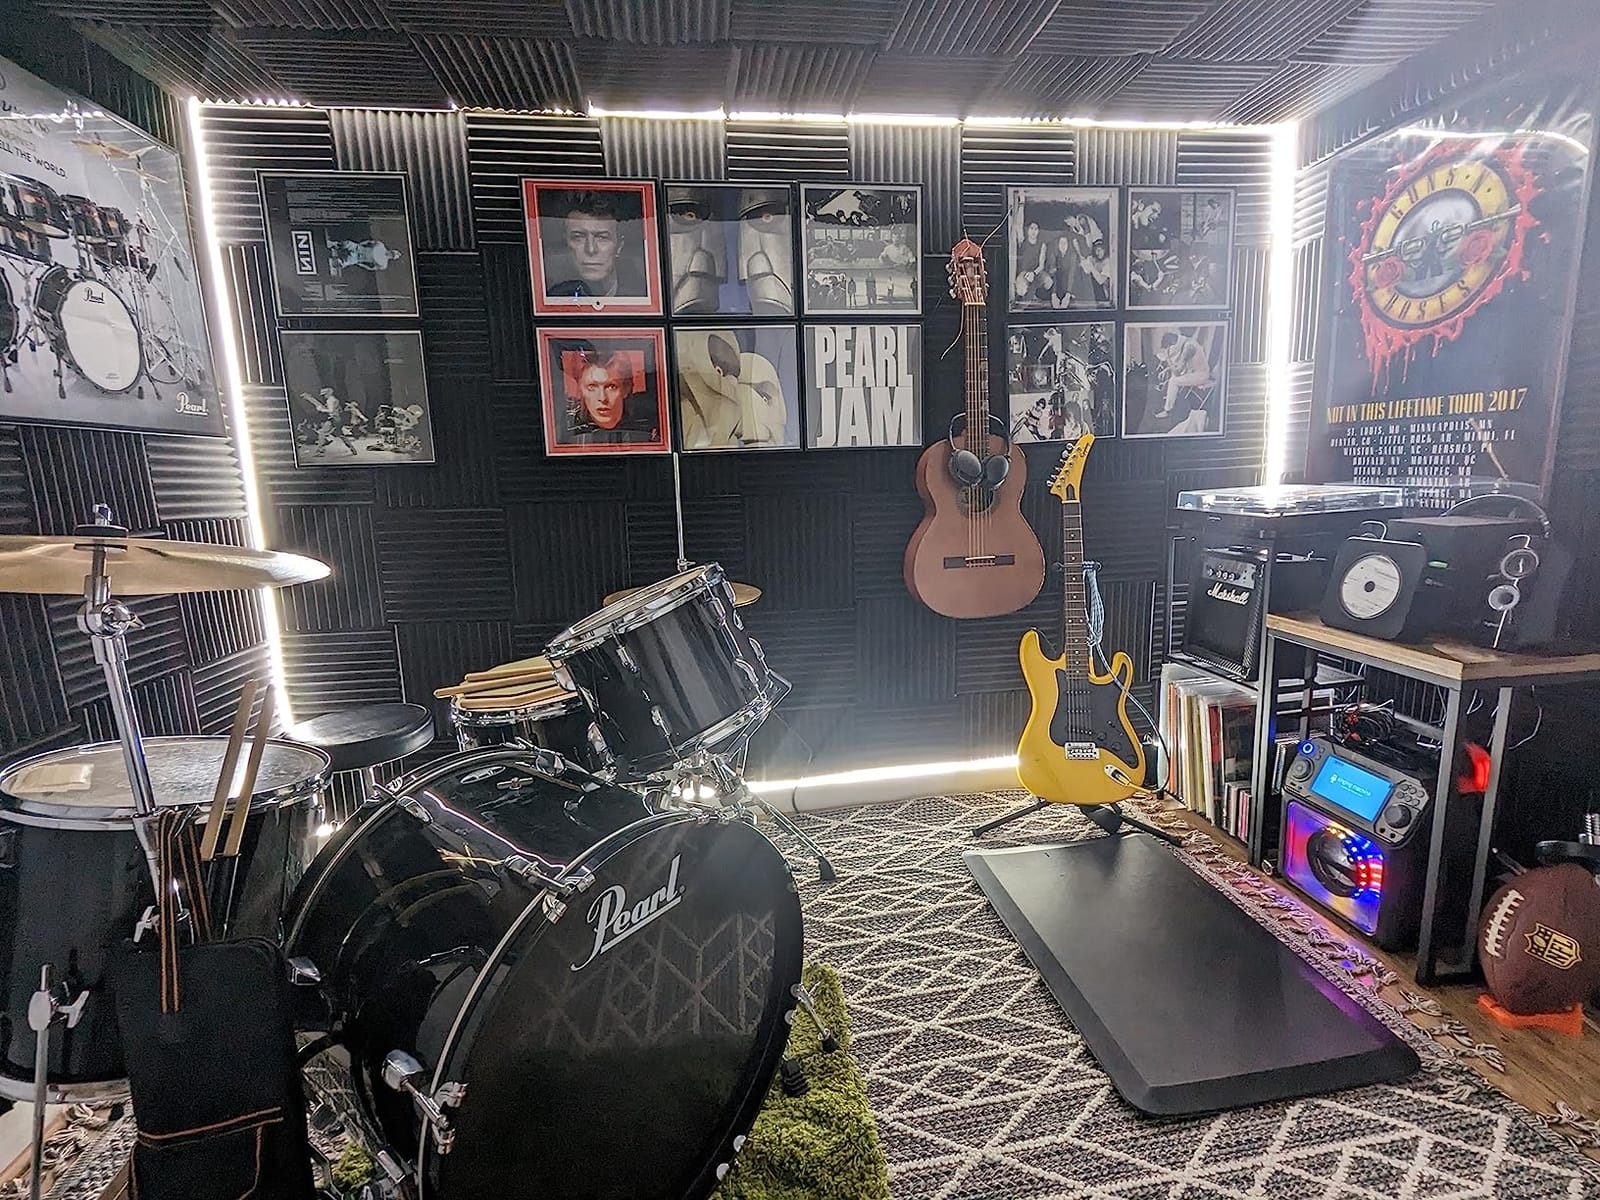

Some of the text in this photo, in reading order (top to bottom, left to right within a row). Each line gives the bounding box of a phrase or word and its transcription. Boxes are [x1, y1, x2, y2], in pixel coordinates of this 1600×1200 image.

[14, 146, 31, 162] THE
[33, 156, 67, 178] WORLD
[84, 286, 105, 304] Pearl
[815, 326, 913, 388] PEARL
[175, 392, 208, 415] Pearl
[816, 387, 913, 447] JAM
[1327, 387, 1528, 424] NOT IN THIS LIFETIME TOUR 2017
[1207, 582, 1250, 605] Marshall
[570, 853, 682, 971] Pearl
[1544, 933, 1576, 967] NFL
